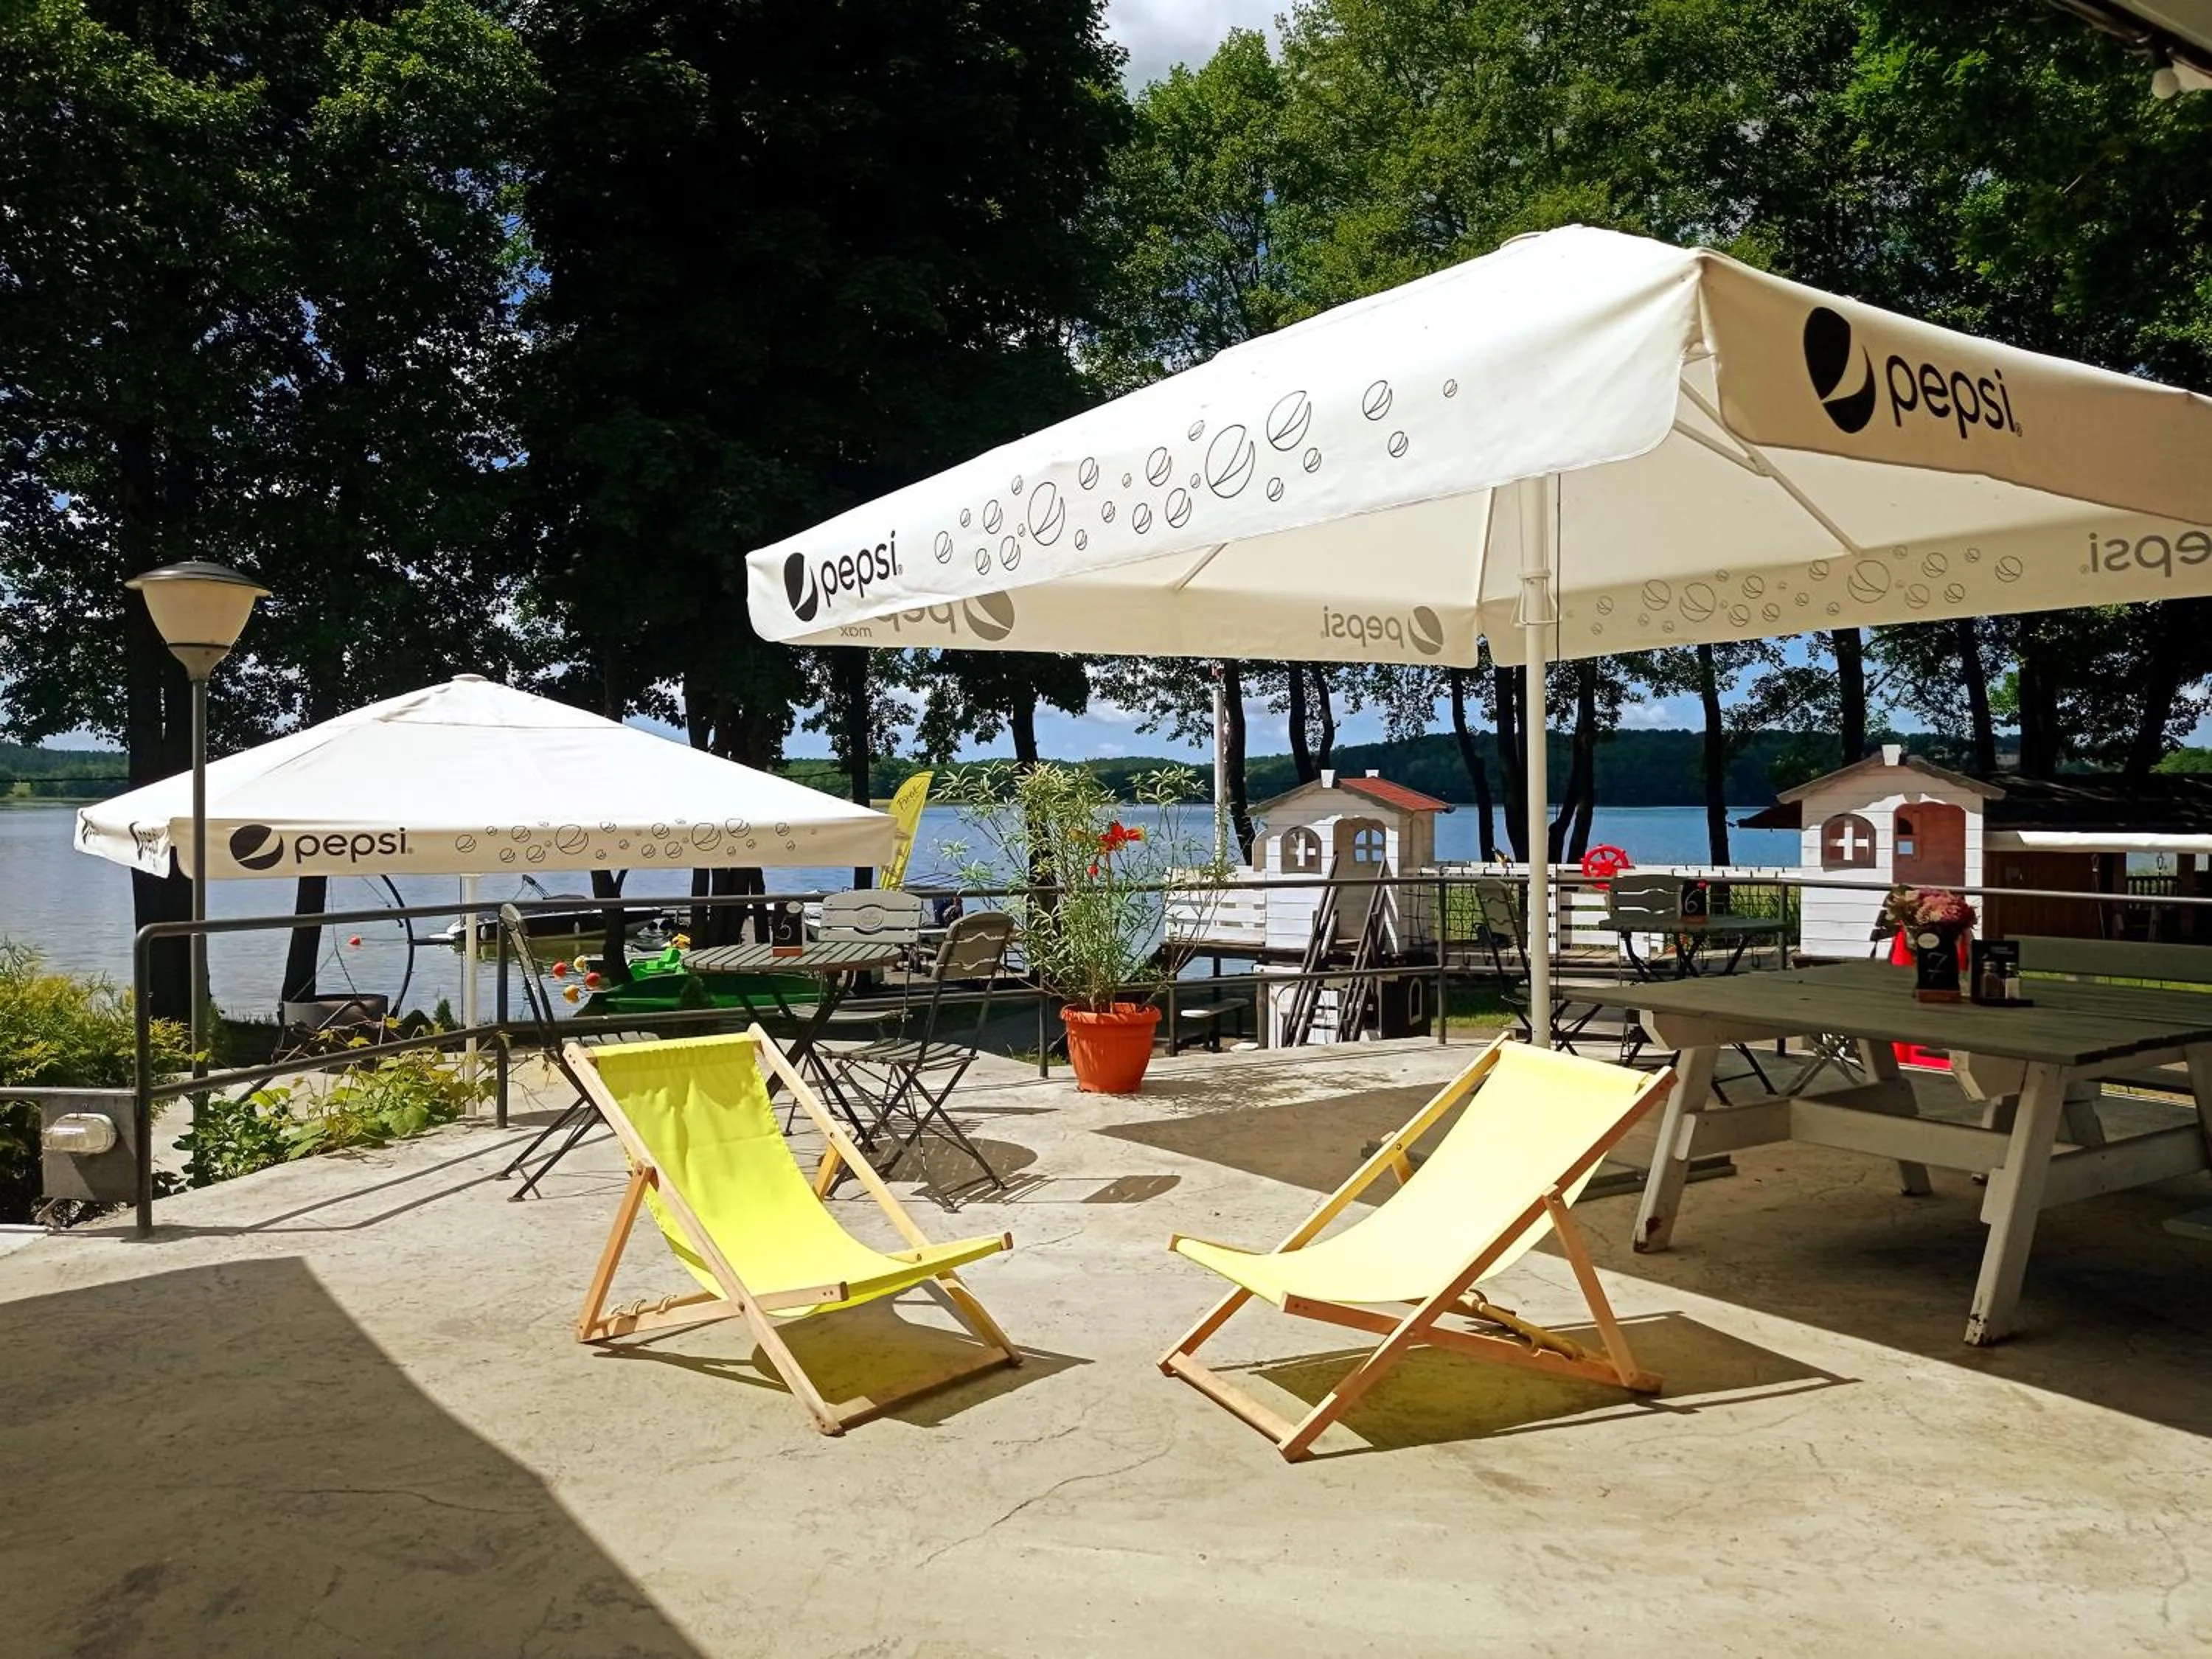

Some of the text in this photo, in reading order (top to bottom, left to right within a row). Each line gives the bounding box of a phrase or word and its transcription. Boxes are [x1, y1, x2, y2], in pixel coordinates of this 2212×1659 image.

[1886, 355, 2015, 439] pepsi
[821, 529, 897, 608] pepsi
[295, 827, 408, 863] pepsi
[1685, 889, 1702, 914] 6
[775, 914, 793, 940] 5
[1927, 951, 1948, 981] 7
